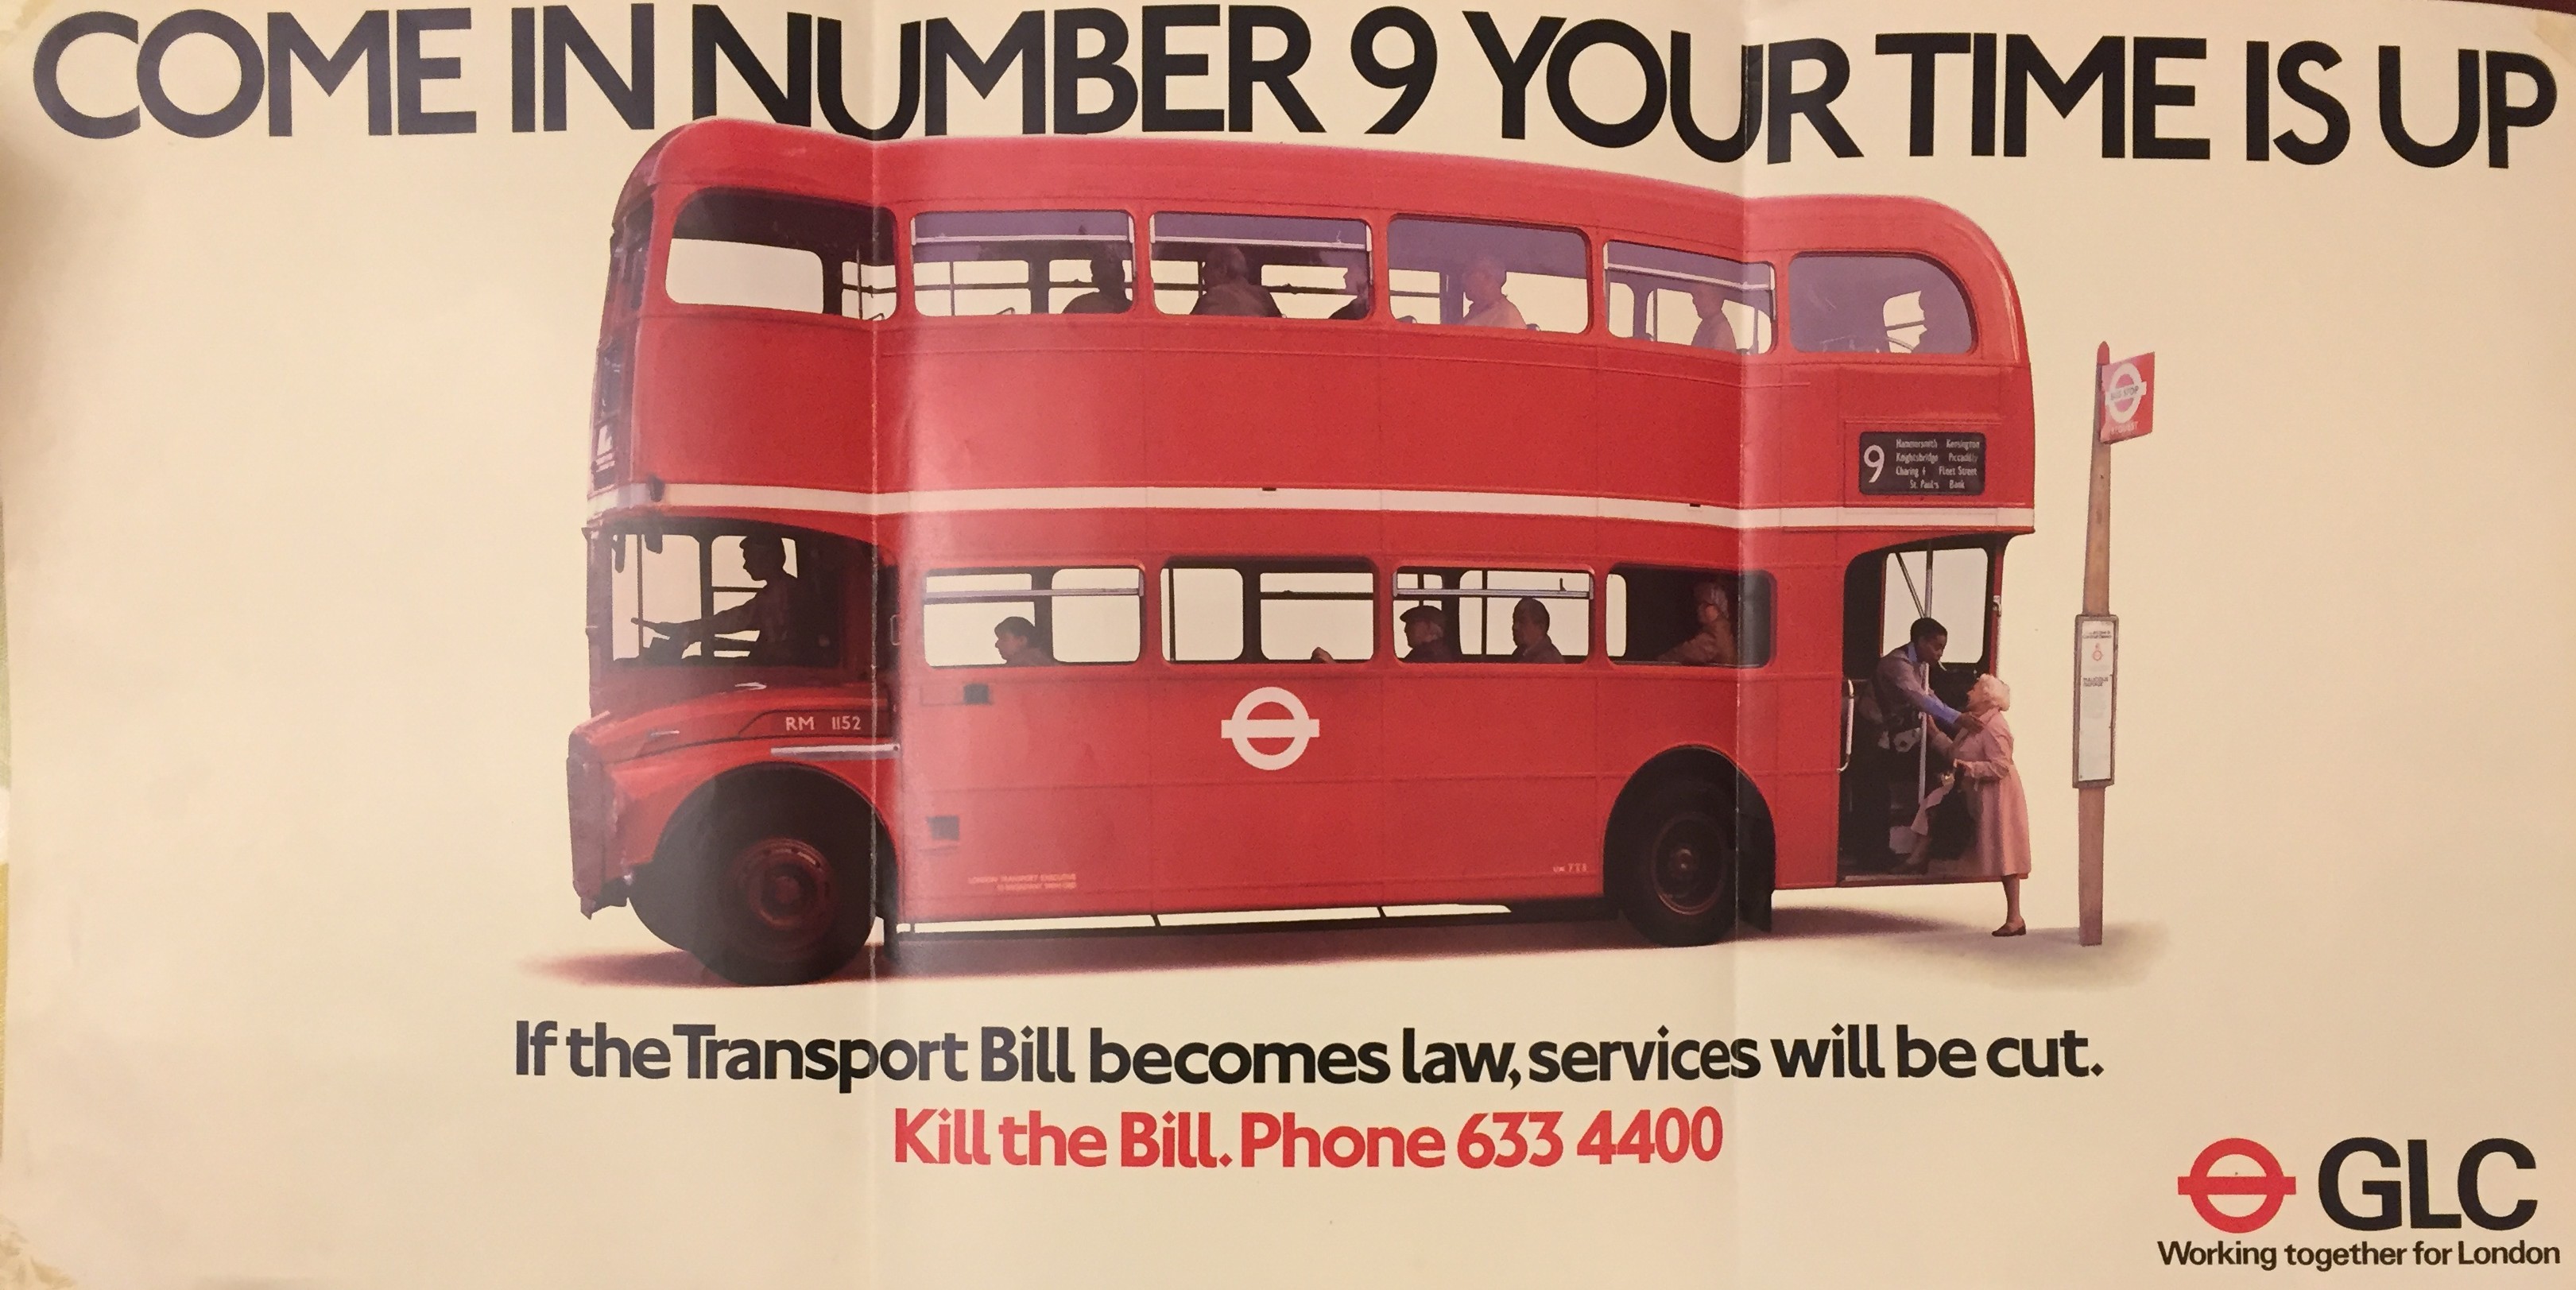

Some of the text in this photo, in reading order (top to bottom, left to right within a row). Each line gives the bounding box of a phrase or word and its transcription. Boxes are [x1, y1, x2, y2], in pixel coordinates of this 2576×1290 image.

[33, 3, 2557, 169] COME IN NUMBER 9 YOUR TIME IS UP
[1863, 444, 1885, 483] 9
[1958, 465, 1978, 476] Street
[785, 715, 861, 730] RM 1152
[517, 1021, 2103, 1094] If the Transport Bill becomes law, services will be cut.
[895, 1106, 1722, 1168] Kill the Bill. Phone 633 4400
[2318, 1137, 2537, 1231] GLC
[2158, 1240, 2559, 1272] Working together for London
